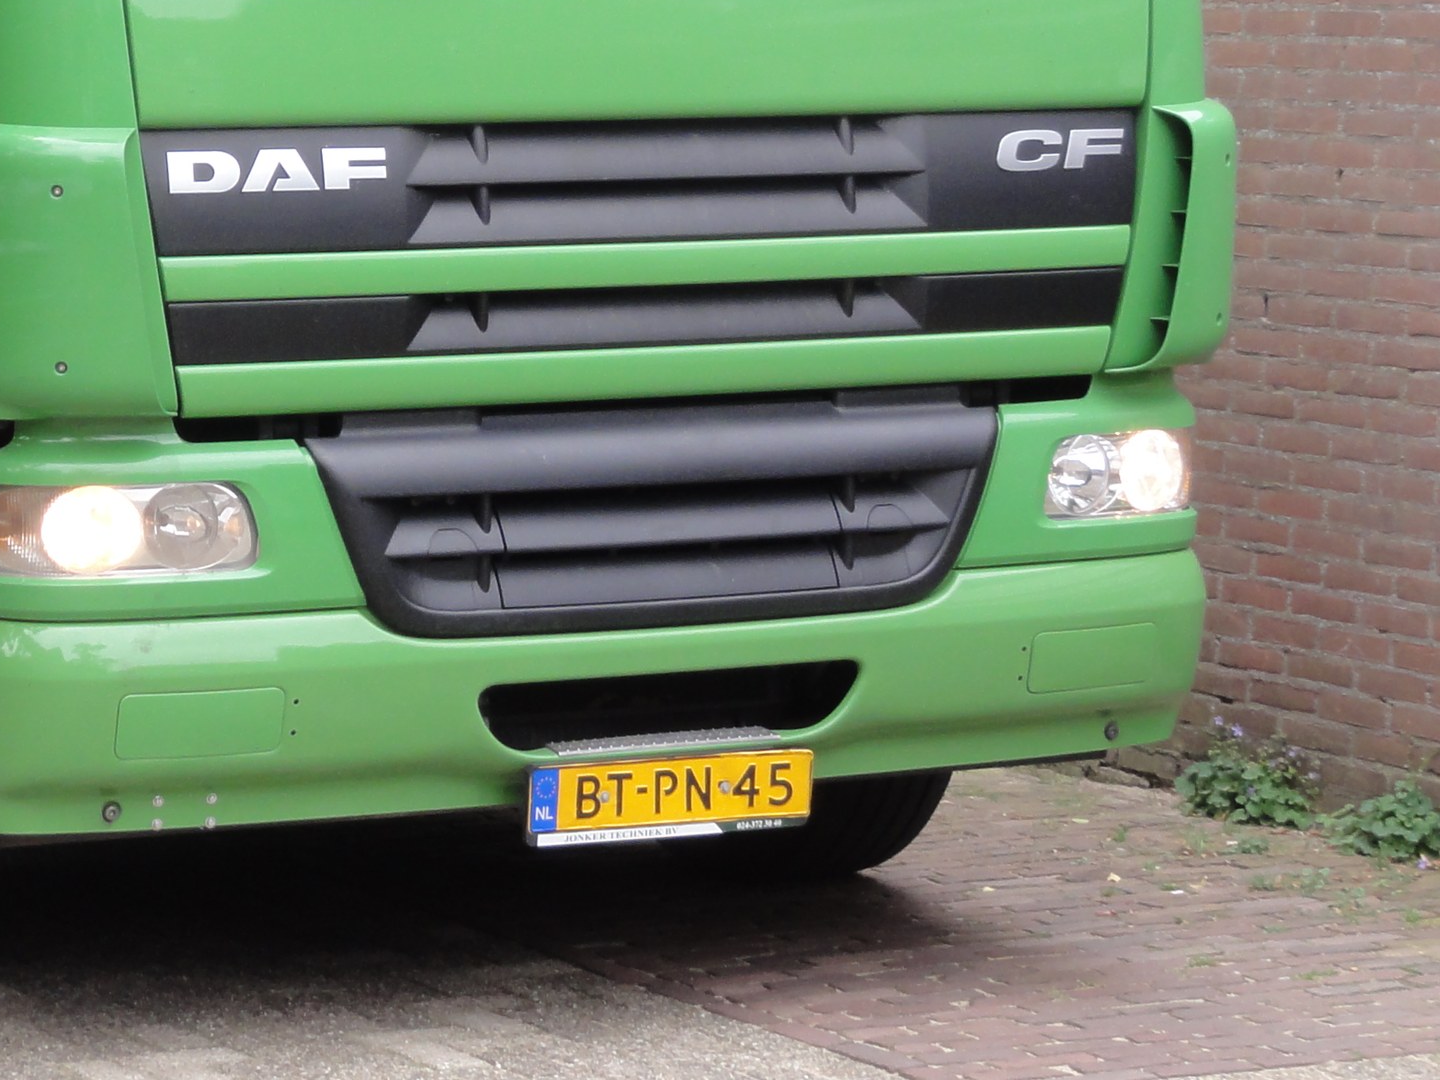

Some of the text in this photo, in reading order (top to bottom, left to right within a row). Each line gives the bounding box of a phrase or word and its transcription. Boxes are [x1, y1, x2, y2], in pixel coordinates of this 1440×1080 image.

[996, 128, 1124, 172] CF
[166, 147, 387, 194] DAF
[535, 806, 554, 821] NL
[564, 832, 608, 843] JONKER
[610, 828, 663, 840] TECHNIEK
